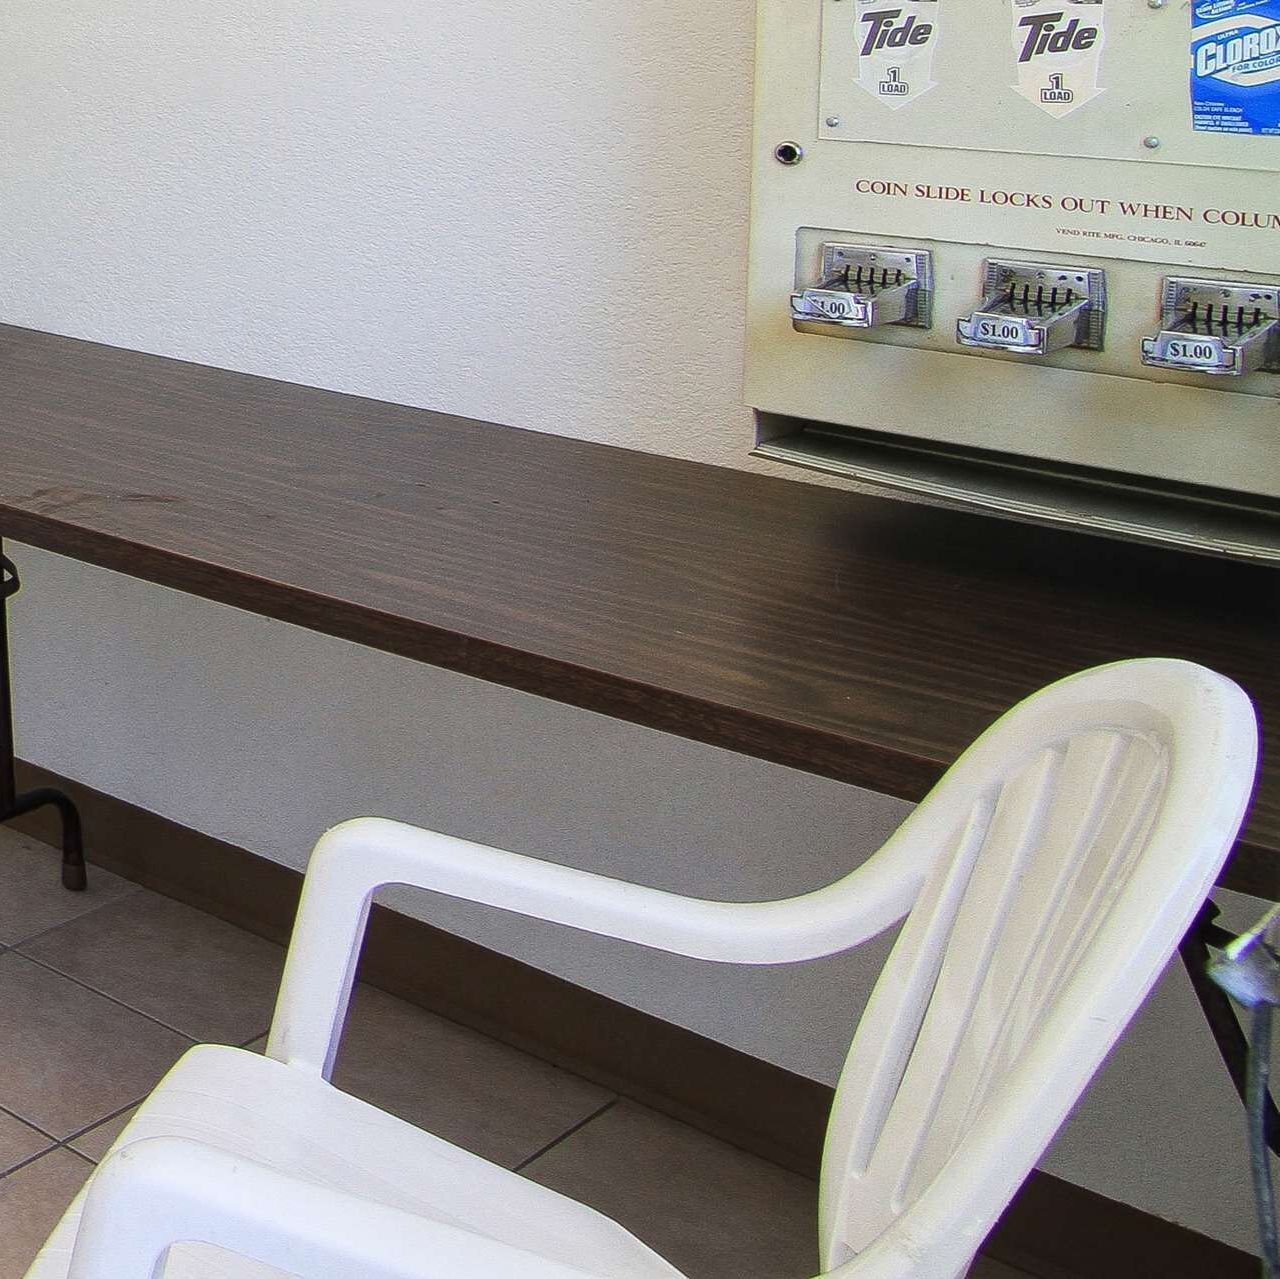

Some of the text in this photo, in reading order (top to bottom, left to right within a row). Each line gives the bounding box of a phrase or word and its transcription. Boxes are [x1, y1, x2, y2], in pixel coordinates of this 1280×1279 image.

[859, 8, 933, 57] Tide
[1017, 11, 1098, 63] Tide
[888, 68, 899, 82] 1
[1232, 63, 1249, 72] FOR
[881, 83, 906, 94] LOAD
[1050, 74, 1061, 90] 1
[1043, 90, 1070, 101] LOAD
[855, 179, 908, 197] COIN
[914, 184, 971, 202] SLIDE
[979, 189, 1053, 209] LOCKS
[1061, 196, 1110, 214] OUT
[1119, 201, 1193, 221] WHEN
[1055, 227, 1080, 236] VEND
[1082, 230, 1101, 238] RITE
[1127, 235, 1172, 246] CHICAGO,
[814, 299, 845, 314] 1.00
[980, 322, 1019, 339] $1.00
[1169, 342, 1212, 359] $1.00
